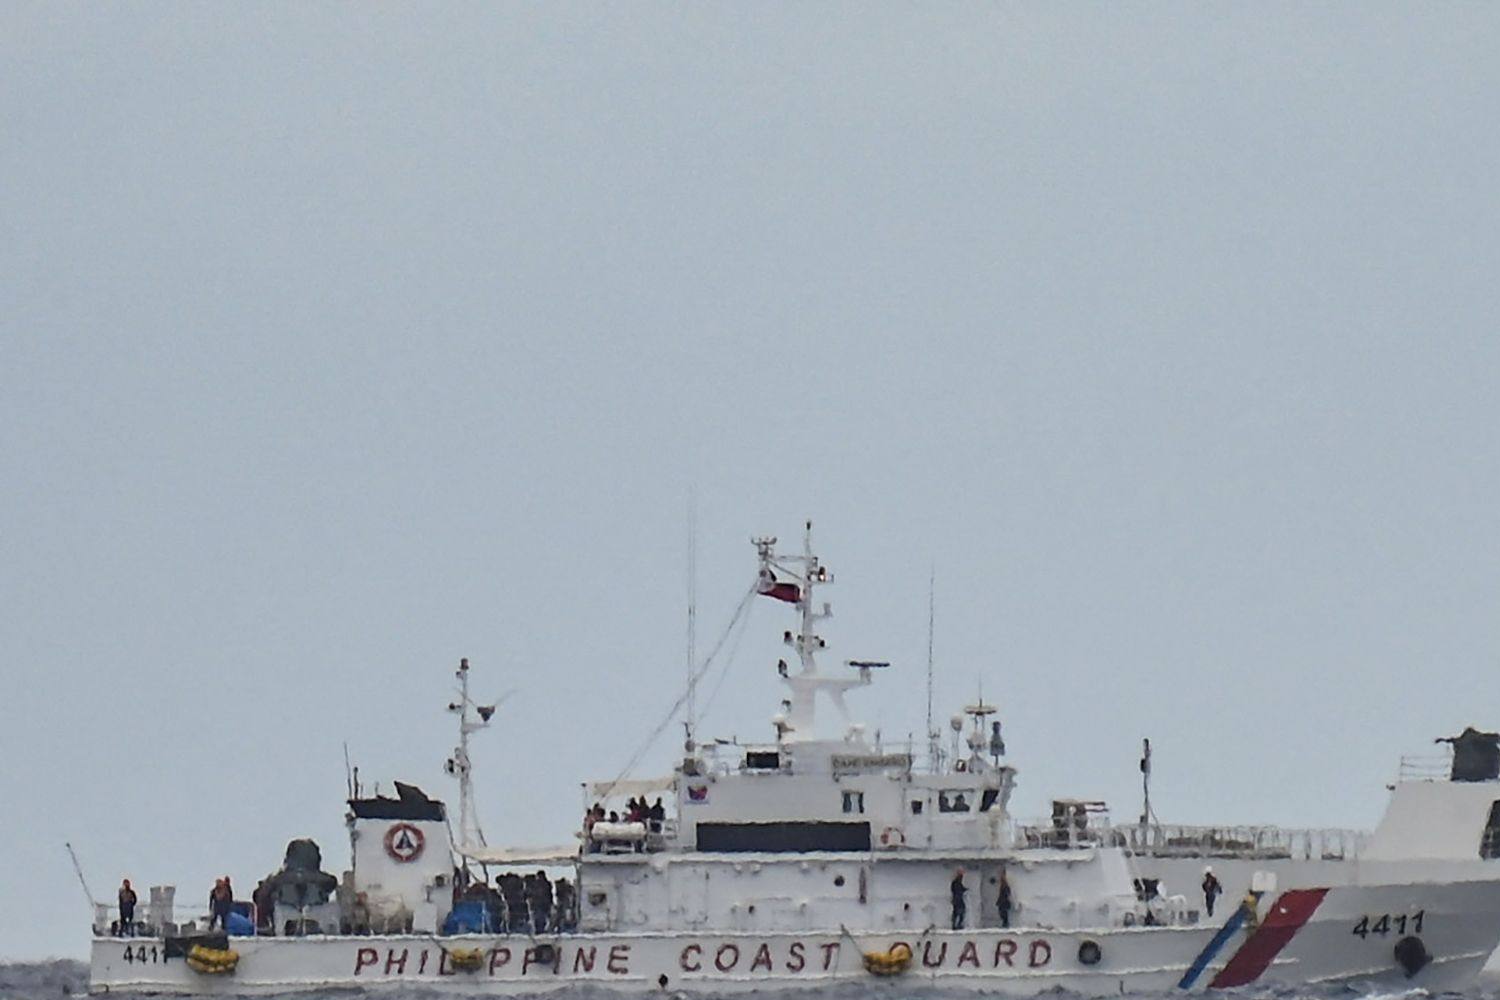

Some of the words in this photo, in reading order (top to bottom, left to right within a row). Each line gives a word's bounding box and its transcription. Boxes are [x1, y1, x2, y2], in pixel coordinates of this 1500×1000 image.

[1352, 909, 1425, 940] 4411
[353, 944, 632, 977] PHILPPINE
[678, 940, 841, 974] COAST
